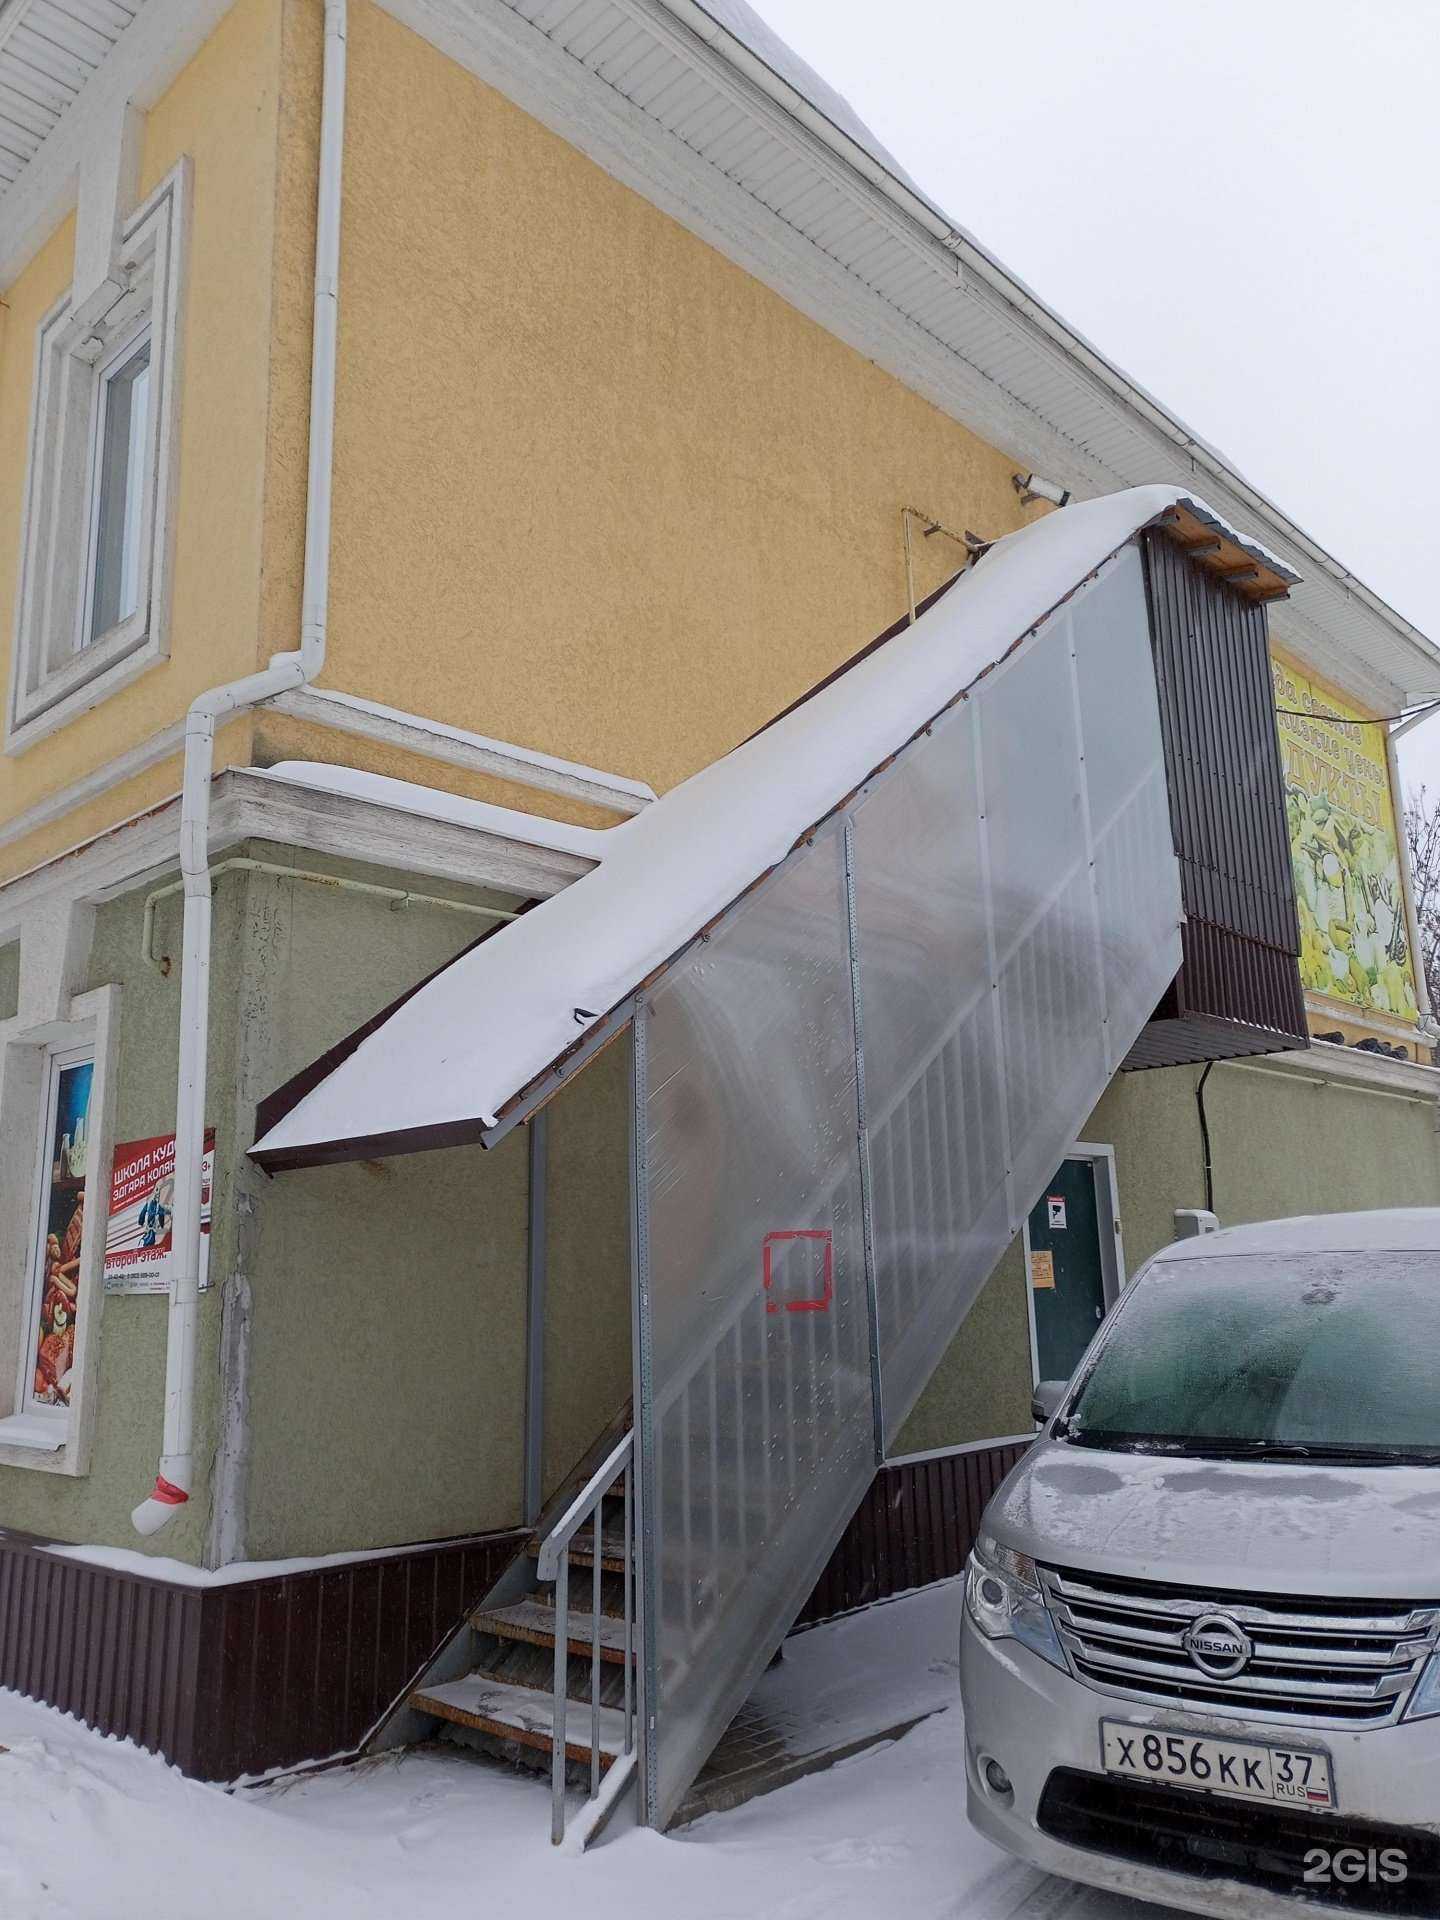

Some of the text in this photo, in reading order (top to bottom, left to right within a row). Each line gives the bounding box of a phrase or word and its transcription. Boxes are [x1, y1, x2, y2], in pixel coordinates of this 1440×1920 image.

[114, 1140, 176, 1186] ШКОЛА КУД
[112, 1174, 146, 1201] ЭДГАРА
[1190, 1639, 1243, 1654] NISSAN
[1275, 1752, 1313, 1785] 37
[1276, 1783, 1306, 1798] RUS
